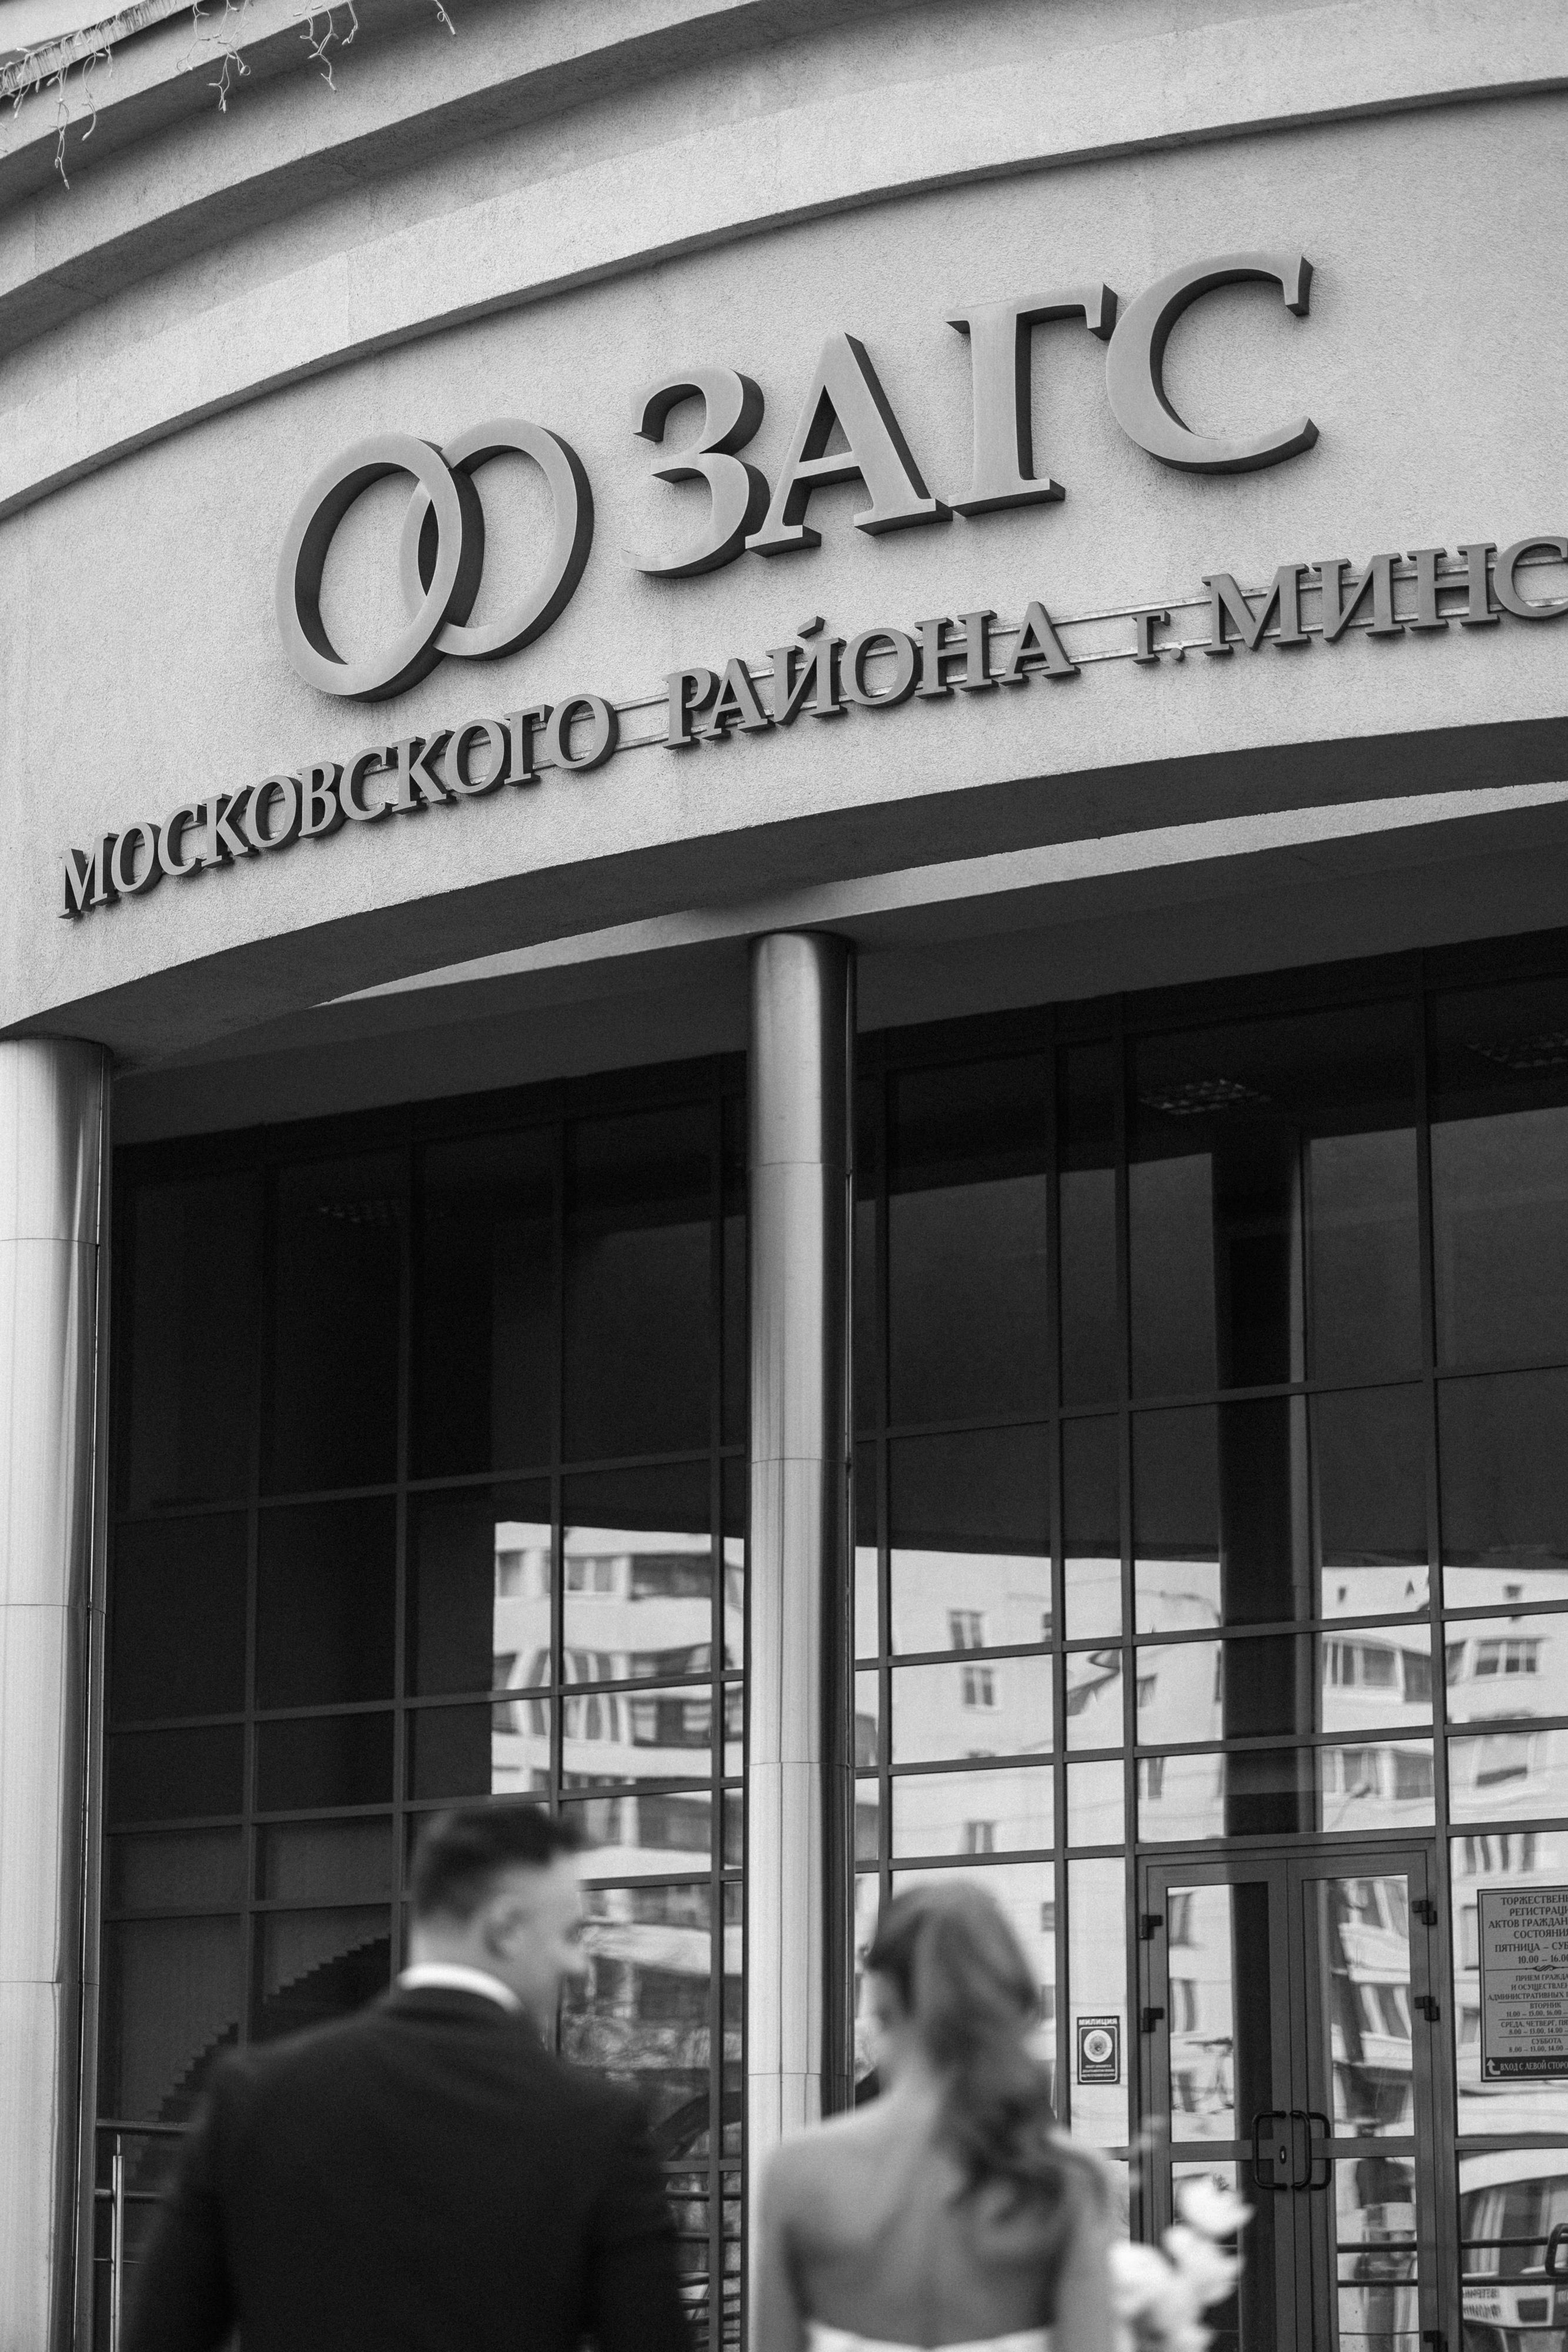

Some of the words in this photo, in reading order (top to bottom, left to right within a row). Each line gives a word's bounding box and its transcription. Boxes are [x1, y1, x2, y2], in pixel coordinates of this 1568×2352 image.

[620, 250, 1320, 579] ЗАГС
[58, 693, 619, 919] МОСКОВСКОГО
[662, 600, 1082, 751] РАЙОНА
[1200, 535, 1568, 658] МИНС
[1488, 1919, 1520, 1929] АКТОВ
[1521, 1917, 1568, 1928] ГРАЖДАН
[1494, 1943, 1540, 1953] ПЯТНИЦА
[1518, 1955, 1539, 1964] 10.00
[1487, 1992, 1564, 2001] АДМИНИСТРАТИВНЫХ
[1525, 2059, 1546, 2070] ЛЕВОЙ
